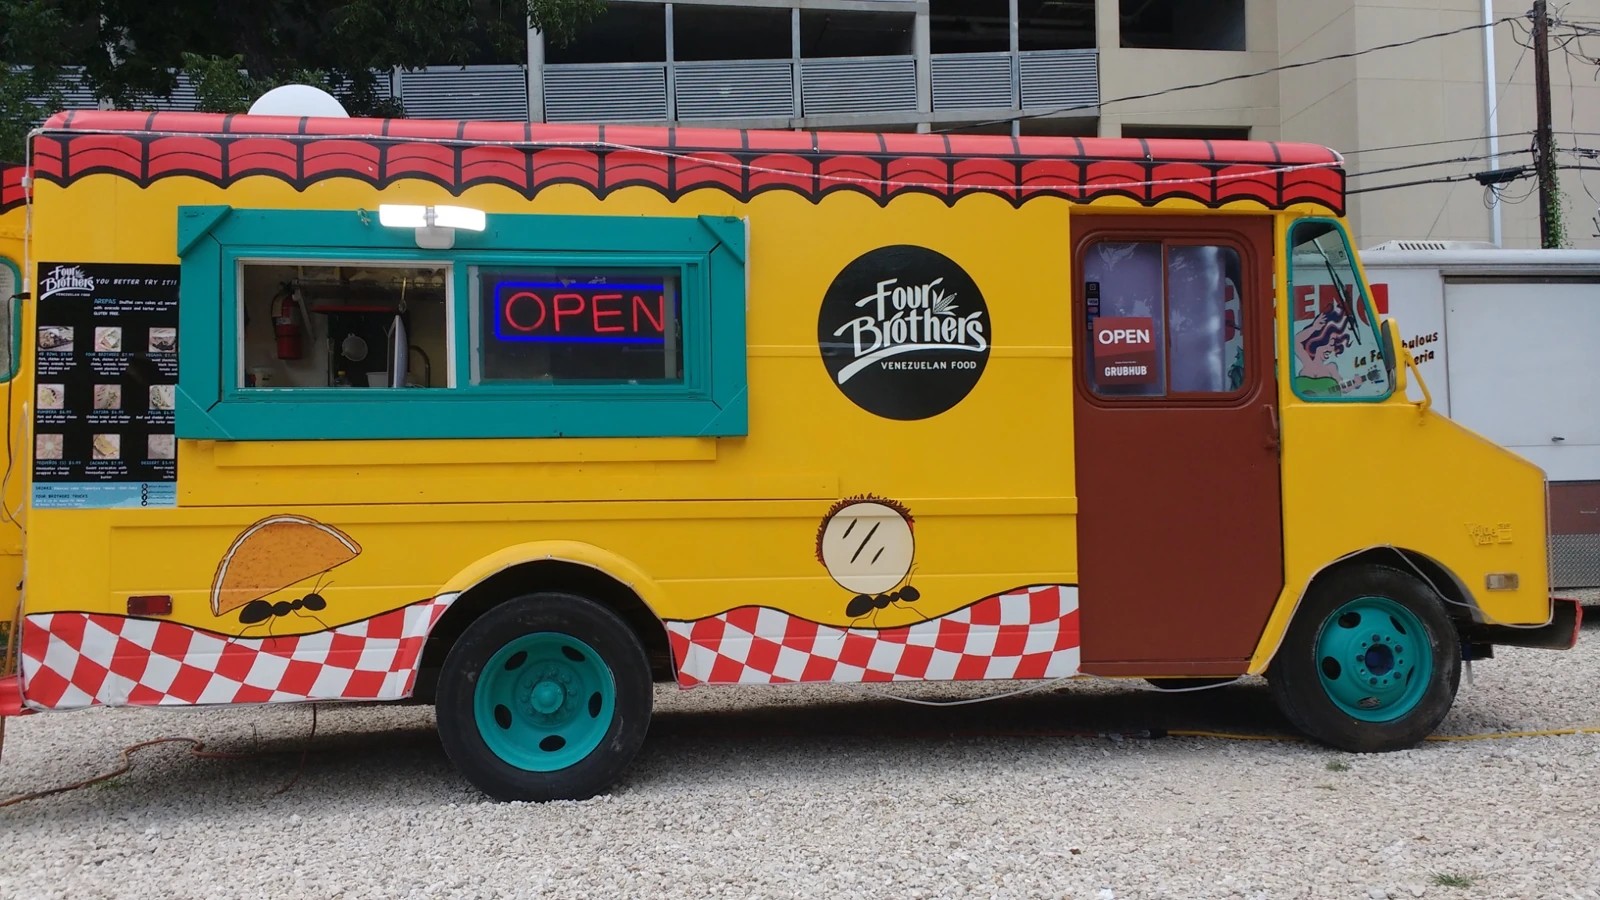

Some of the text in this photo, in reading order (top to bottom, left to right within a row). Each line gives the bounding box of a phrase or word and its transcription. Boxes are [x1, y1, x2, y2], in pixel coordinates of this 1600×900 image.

[48, 265, 80, 279] Four
[40, 276, 95, 300] Brothers
[855, 277, 943, 322] Four
[505, 291, 664, 333] OPEN
[1099, 329, 1149, 344] OPEN
[833, 310, 987, 384] Brothers
[881, 361, 977, 370] VENEZUELAN FOOD
[1354, 356, 1366, 368] La
[1105, 366, 1147, 376] GRUBHUB
